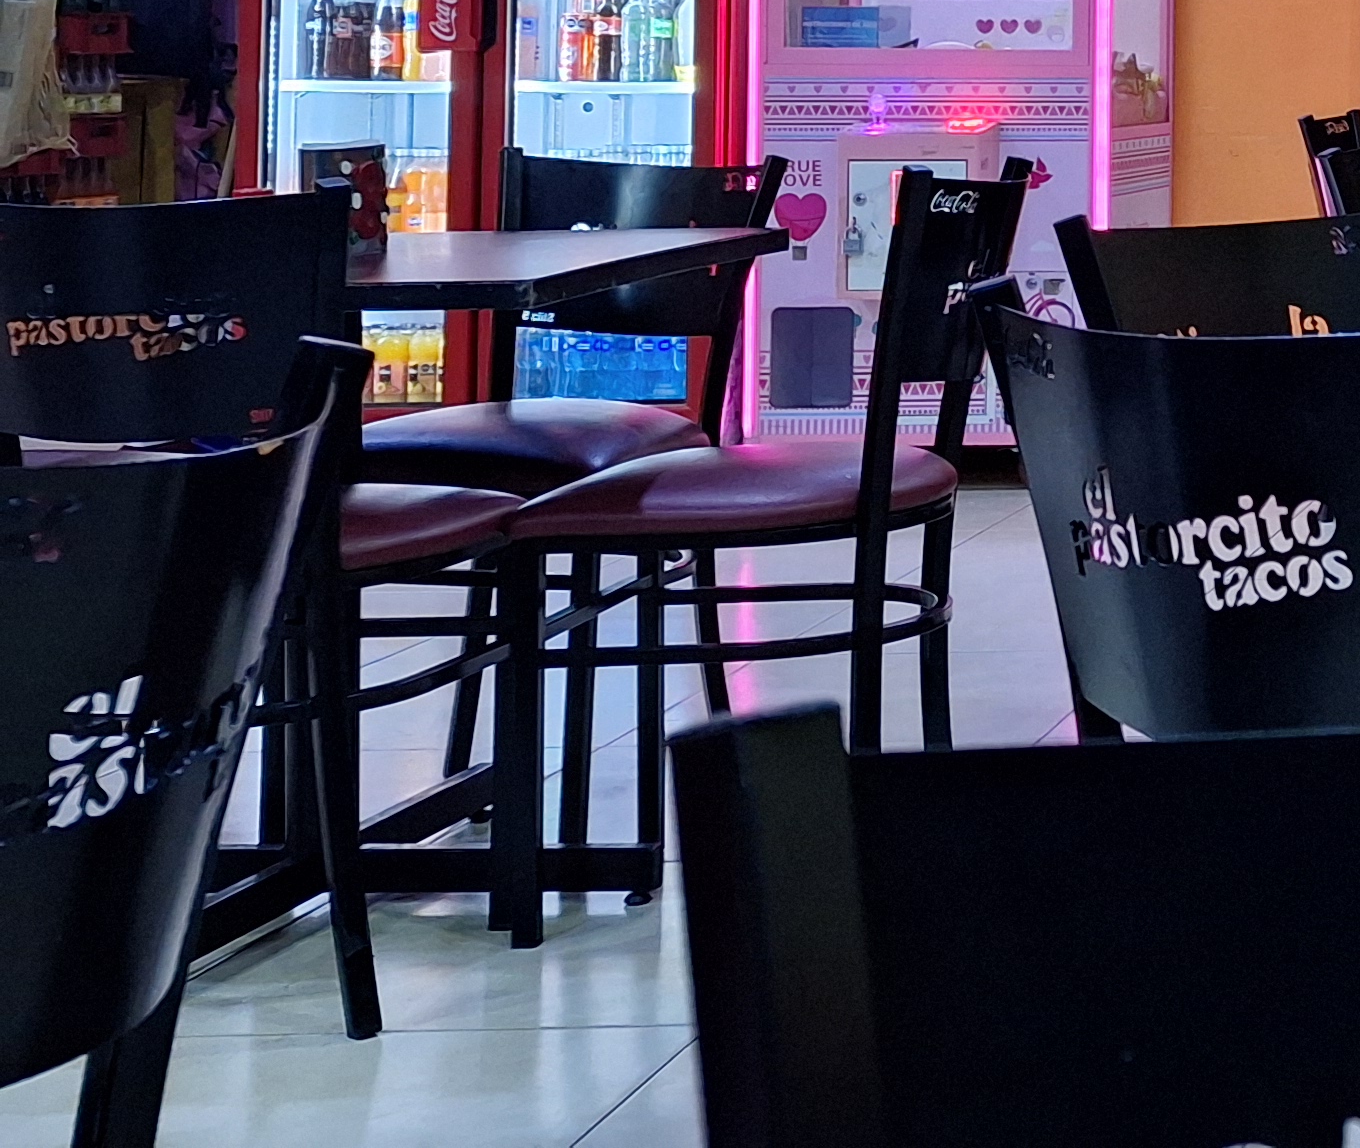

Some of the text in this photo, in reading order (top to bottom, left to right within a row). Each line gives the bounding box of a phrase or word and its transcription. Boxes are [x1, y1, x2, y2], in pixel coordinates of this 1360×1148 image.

[786, 159, 822, 172] RUE
[784, 174, 822, 187] OVE
[1199, 550, 1354, 612] tacos
